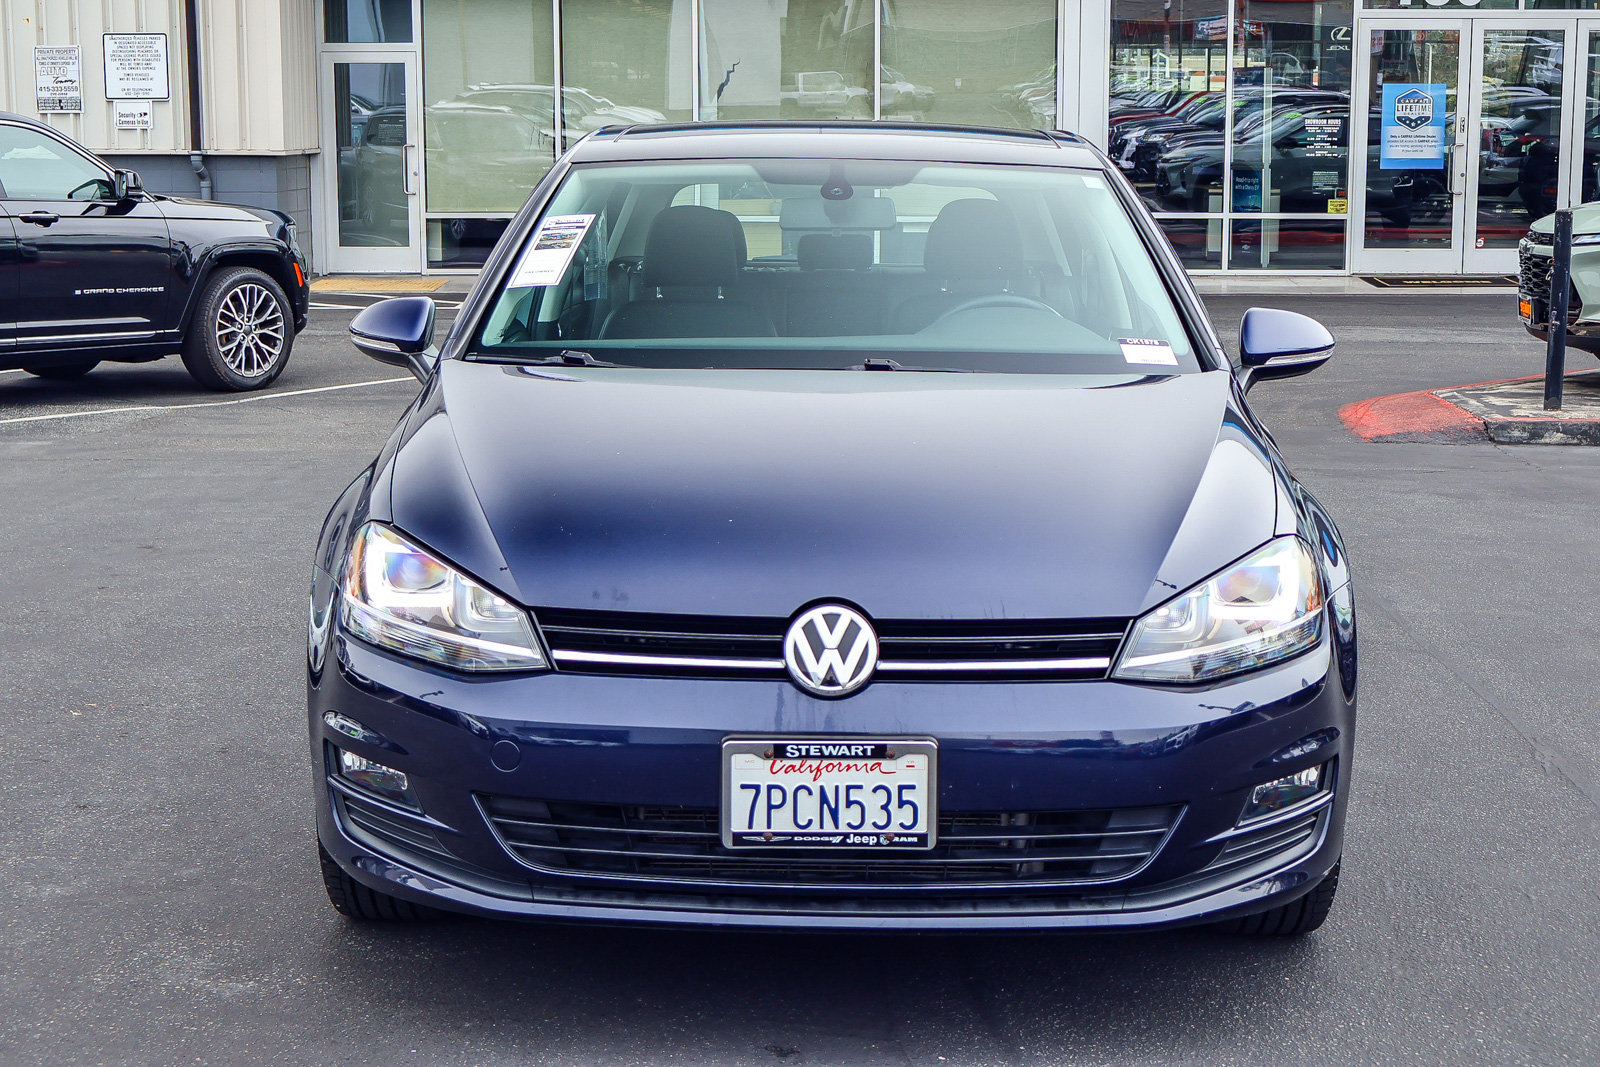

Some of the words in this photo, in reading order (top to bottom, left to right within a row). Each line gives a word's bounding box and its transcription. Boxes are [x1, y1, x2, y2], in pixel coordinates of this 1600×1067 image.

[40, 66, 67, 76] AUTO
[786, 744, 875, 758] STEWART
[770, 759, 896, 782] California
[740, 783, 919, 830] 7PCN535
[846, 834, 877, 845] Jeep
